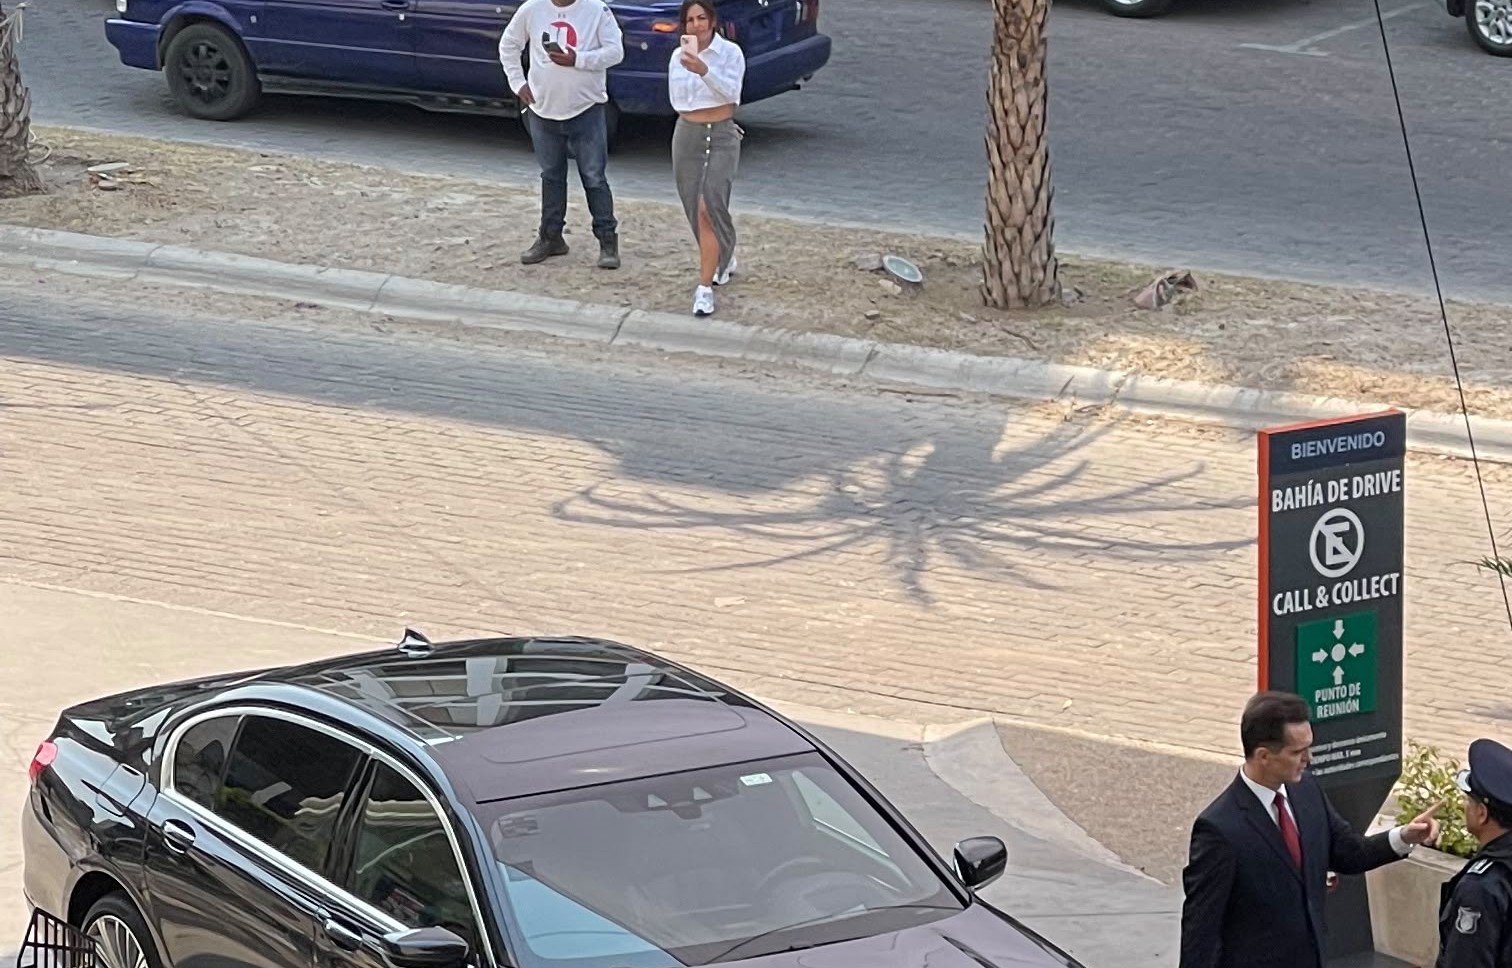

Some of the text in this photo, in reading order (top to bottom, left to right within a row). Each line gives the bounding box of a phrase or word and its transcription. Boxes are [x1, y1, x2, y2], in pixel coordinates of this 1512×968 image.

[1291, 431, 1385, 459] BIENVENIDO
[1272, 470, 1400, 512] BAHÍA DE DRIVE
[1273, 573, 1400, 615] CALL & COLLECT
[1315, 682, 1361, 703] PUNTO DE
[1316, 698, 1360, 719] REUNIÓN
